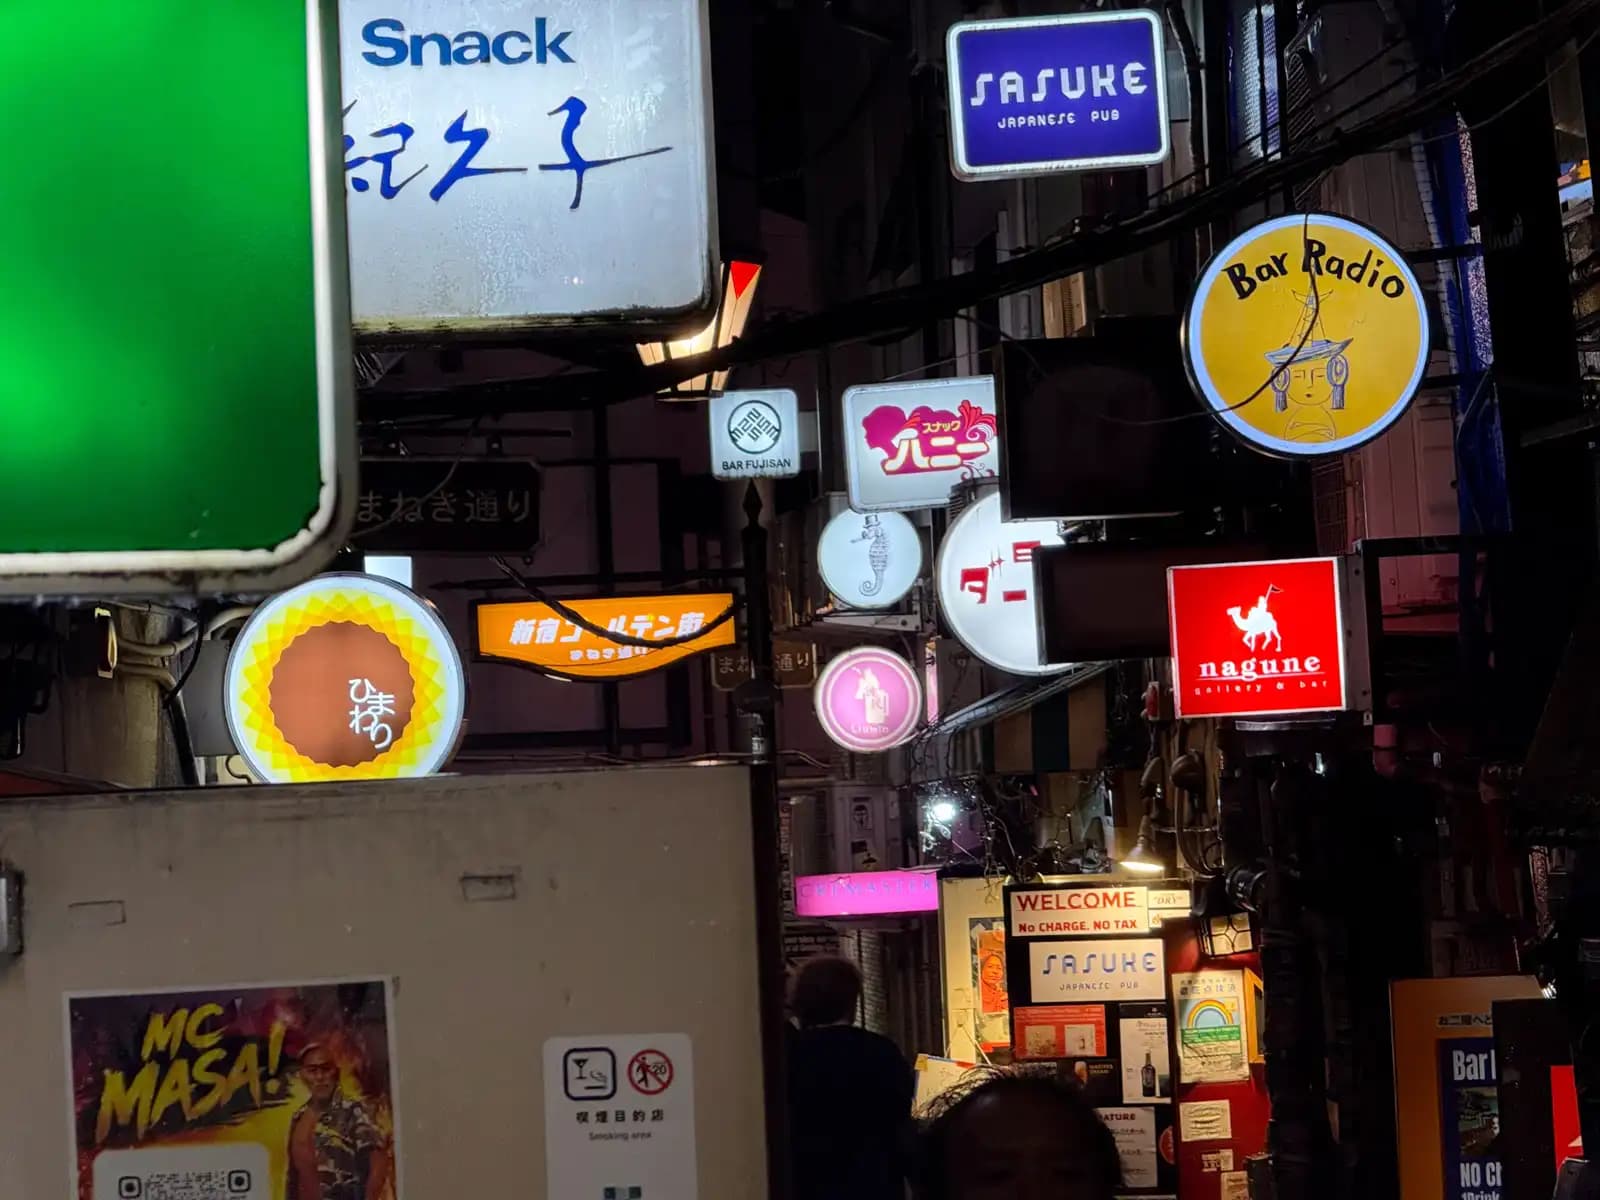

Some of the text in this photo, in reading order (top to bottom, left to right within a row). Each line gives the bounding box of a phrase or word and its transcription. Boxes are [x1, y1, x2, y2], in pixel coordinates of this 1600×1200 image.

[361, 16, 576, 67] Snack
[970, 61, 1148, 107] SASUKE
[997, 109, 1120, 129] JAPANESE PUB
[1221, 237, 1405, 300] Bar Radio
[922, 419, 961, 434] スナック
[884, 428, 991, 472] ハニー
[722, 458, 792, 471] BAR FUJISAN
[357, 488, 531, 523] まねき通り
[718, 651, 810, 675] まね通り
[1199, 655, 1321, 681] nagune
[1299, 679, 1328, 690] bar
[348, 677, 395, 749] ひまわり
[1016, 890, 1137, 912] WELCOME
[1093, 919, 1110, 930] NO
[1114, 919, 1137, 929] TAX
[1042, 952, 1158, 975] SASUKE
[141, 1003, 229, 1062] MC
[1452, 1049, 1489, 1081] Bar
[95, 1019, 288, 1143] MASA!
[588, 1131, 652, 1141] Smoking area
[1459, 1162, 1481, 1188] NO
